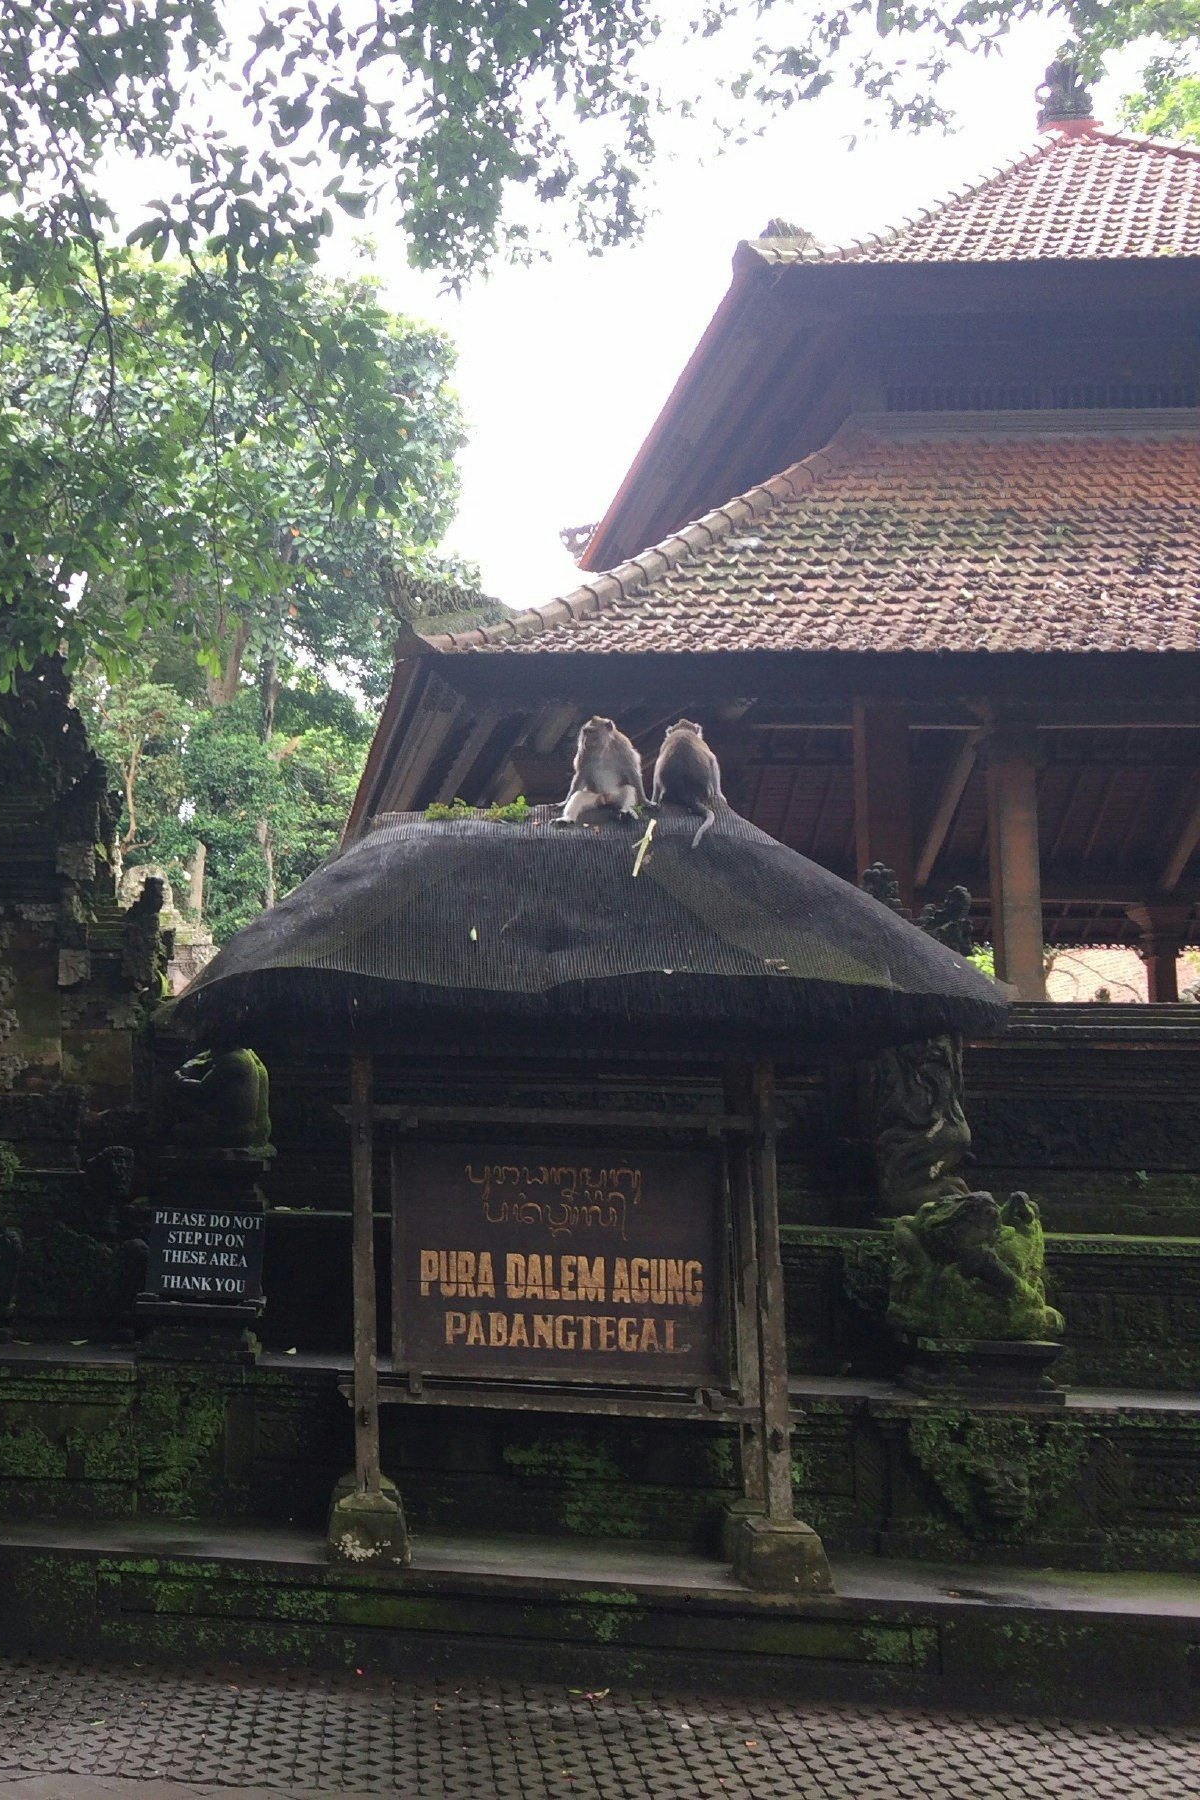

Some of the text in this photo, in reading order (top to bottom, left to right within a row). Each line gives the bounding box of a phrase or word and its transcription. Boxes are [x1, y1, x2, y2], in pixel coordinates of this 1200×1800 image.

[155, 1211, 263, 1230] PLEASE DO NOT
[167, 1231, 246, 1248] STEP UP ON
[162, 1249, 248, 1268] THESE AREA
[161, 1274, 246, 1293] THANK YOU
[419, 1250, 704, 1306] PURA DALEM AGUNG
[444, 1311, 687, 1353] PADANGTEGAL
